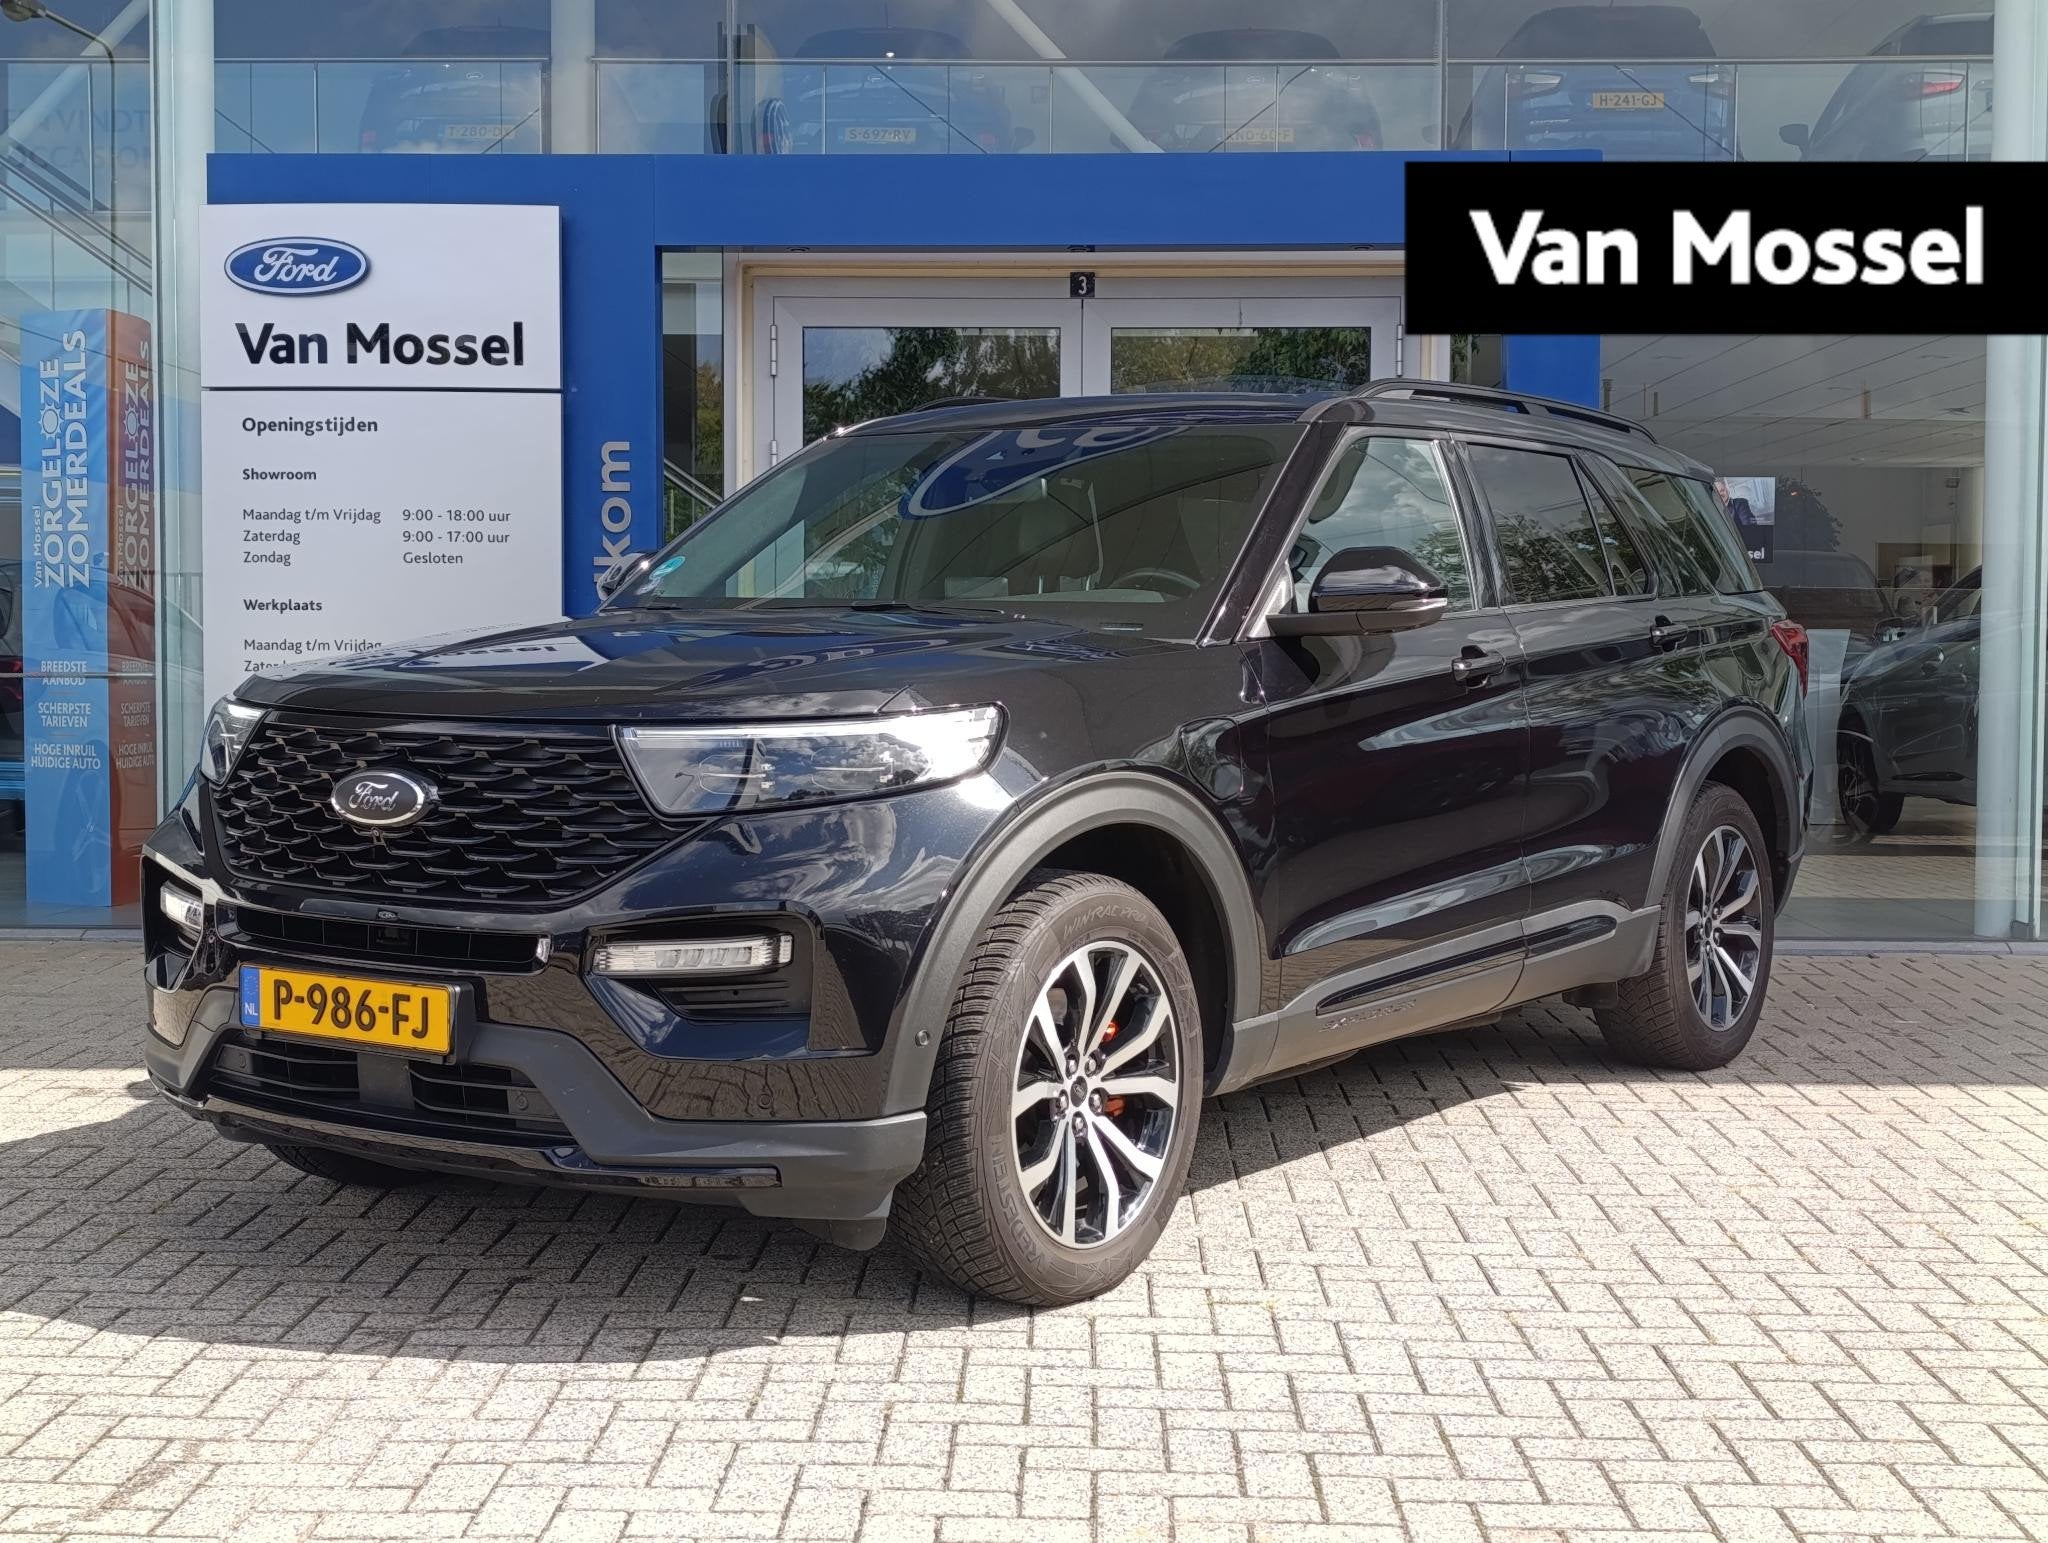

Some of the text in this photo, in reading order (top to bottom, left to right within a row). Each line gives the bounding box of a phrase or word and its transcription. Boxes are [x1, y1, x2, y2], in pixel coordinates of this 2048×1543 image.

[1599, 94, 1657, 106] H-241-GJ
[849, 128, 912, 141] S-697-RV
[253, 246, 341, 282] Ford
[1079, 276, 1087, 294] 3
[234, 321, 524, 366] Van Mossel
[242, 417, 379, 436] Openingstijden
[62, 329, 89, 589] ZOMERDEALS
[139, 341, 151, 594] ZOMERDEALS
[242, 468, 317, 481] Showroom
[243, 508, 302, 524] Maandag
[304, 508, 330, 521] t/m
[333, 508, 381, 524] Vrijdag
[402, 509, 433, 521] 9:00
[447, 509, 485, 522] 18:00
[488, 513, 511, 522] uur
[593, 441, 633, 583] kom
[243, 530, 301, 545] Zaterdag
[402, 530, 433, 542] 9:00
[447, 531, 484, 543] 17:00
[487, 534, 510, 543] uur
[32, 505, 43, 587] Van Mossel
[1747, 547, 1765, 559] sel
[243, 551, 463, 567] Zondag Gesloten
[243, 599, 323, 612] Werkplaats
[244, 638, 303, 654] Maandag
[306, 638, 331, 651] t/m
[41, 661, 87, 673] BREEDSTE
[38, 702, 91, 715] SCHERPSTE
[41, 715, 88, 728] TARIEVEN
[34, 743, 96, 757] HOGE INRUIL
[31, 756, 101, 770] HUIDIGE AUTO
[349, 781, 400, 811] Ford
[244, 1002, 259, 1016] NL
[273, 979, 429, 1040] P-986-FJ
